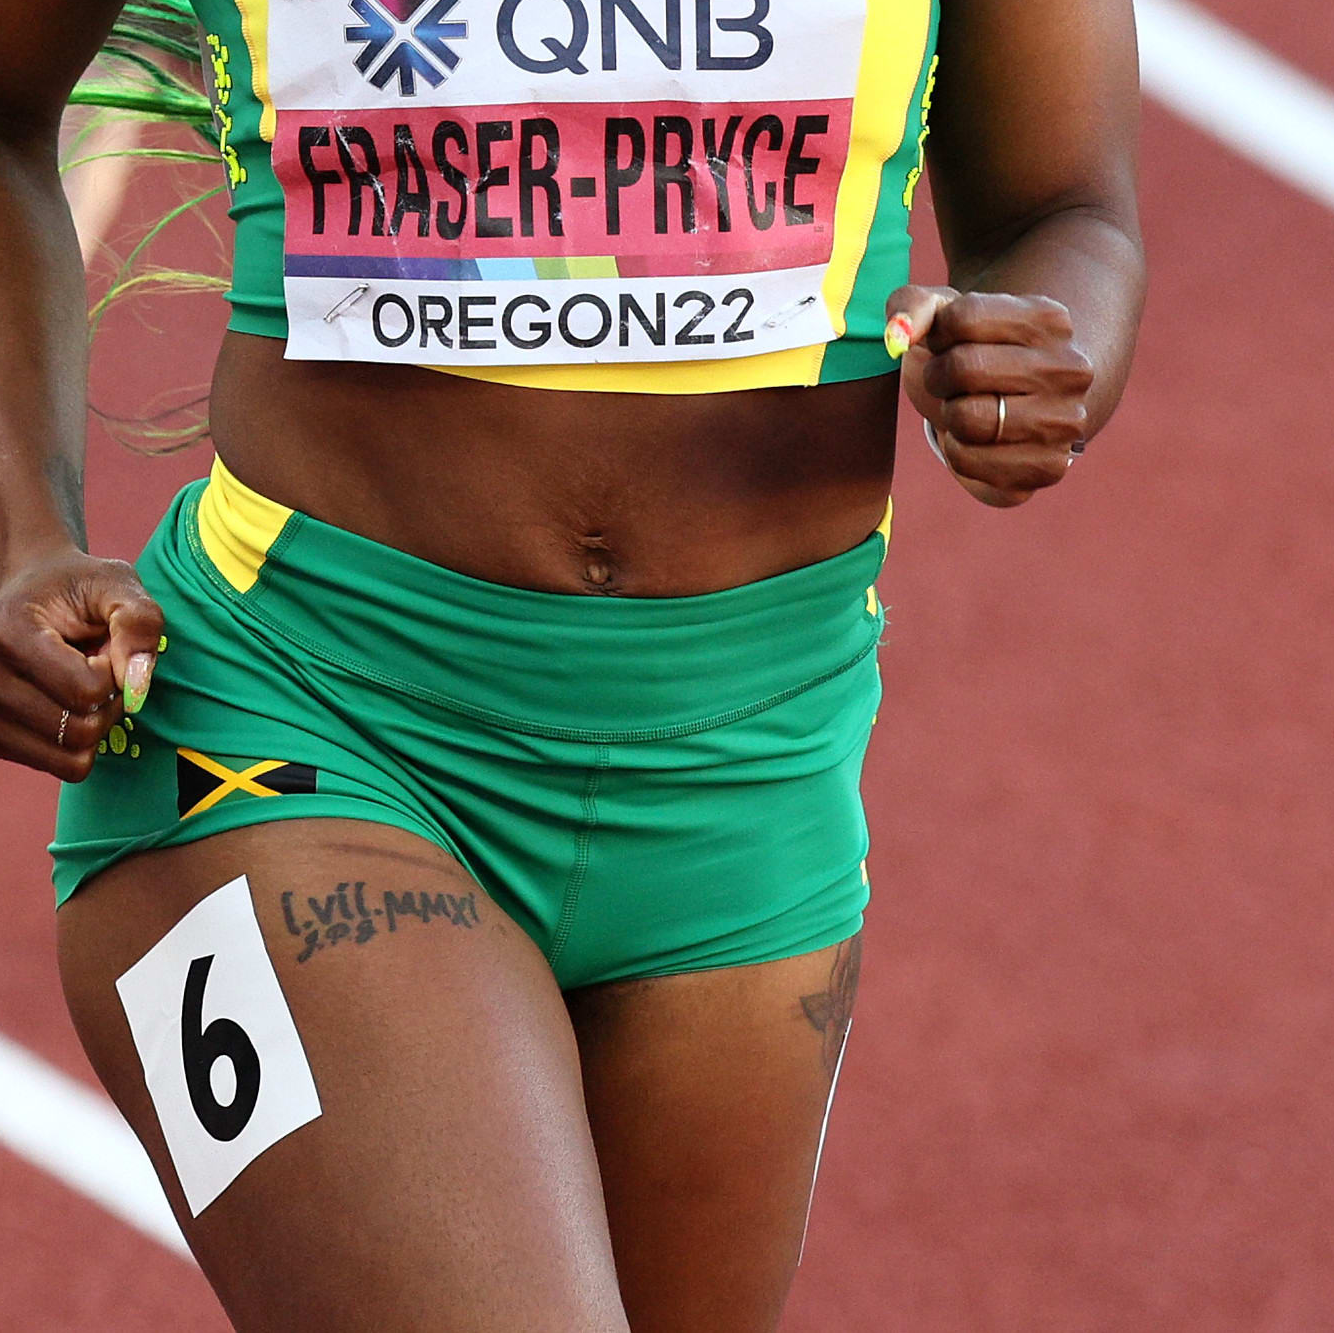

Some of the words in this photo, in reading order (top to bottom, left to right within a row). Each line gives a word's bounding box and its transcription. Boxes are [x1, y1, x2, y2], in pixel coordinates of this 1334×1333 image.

[298, 114, 829, 240] FRASER-PRYCE
[371, 288, 755, 349] OREGON22
[181, 954, 261, 1142] 6
